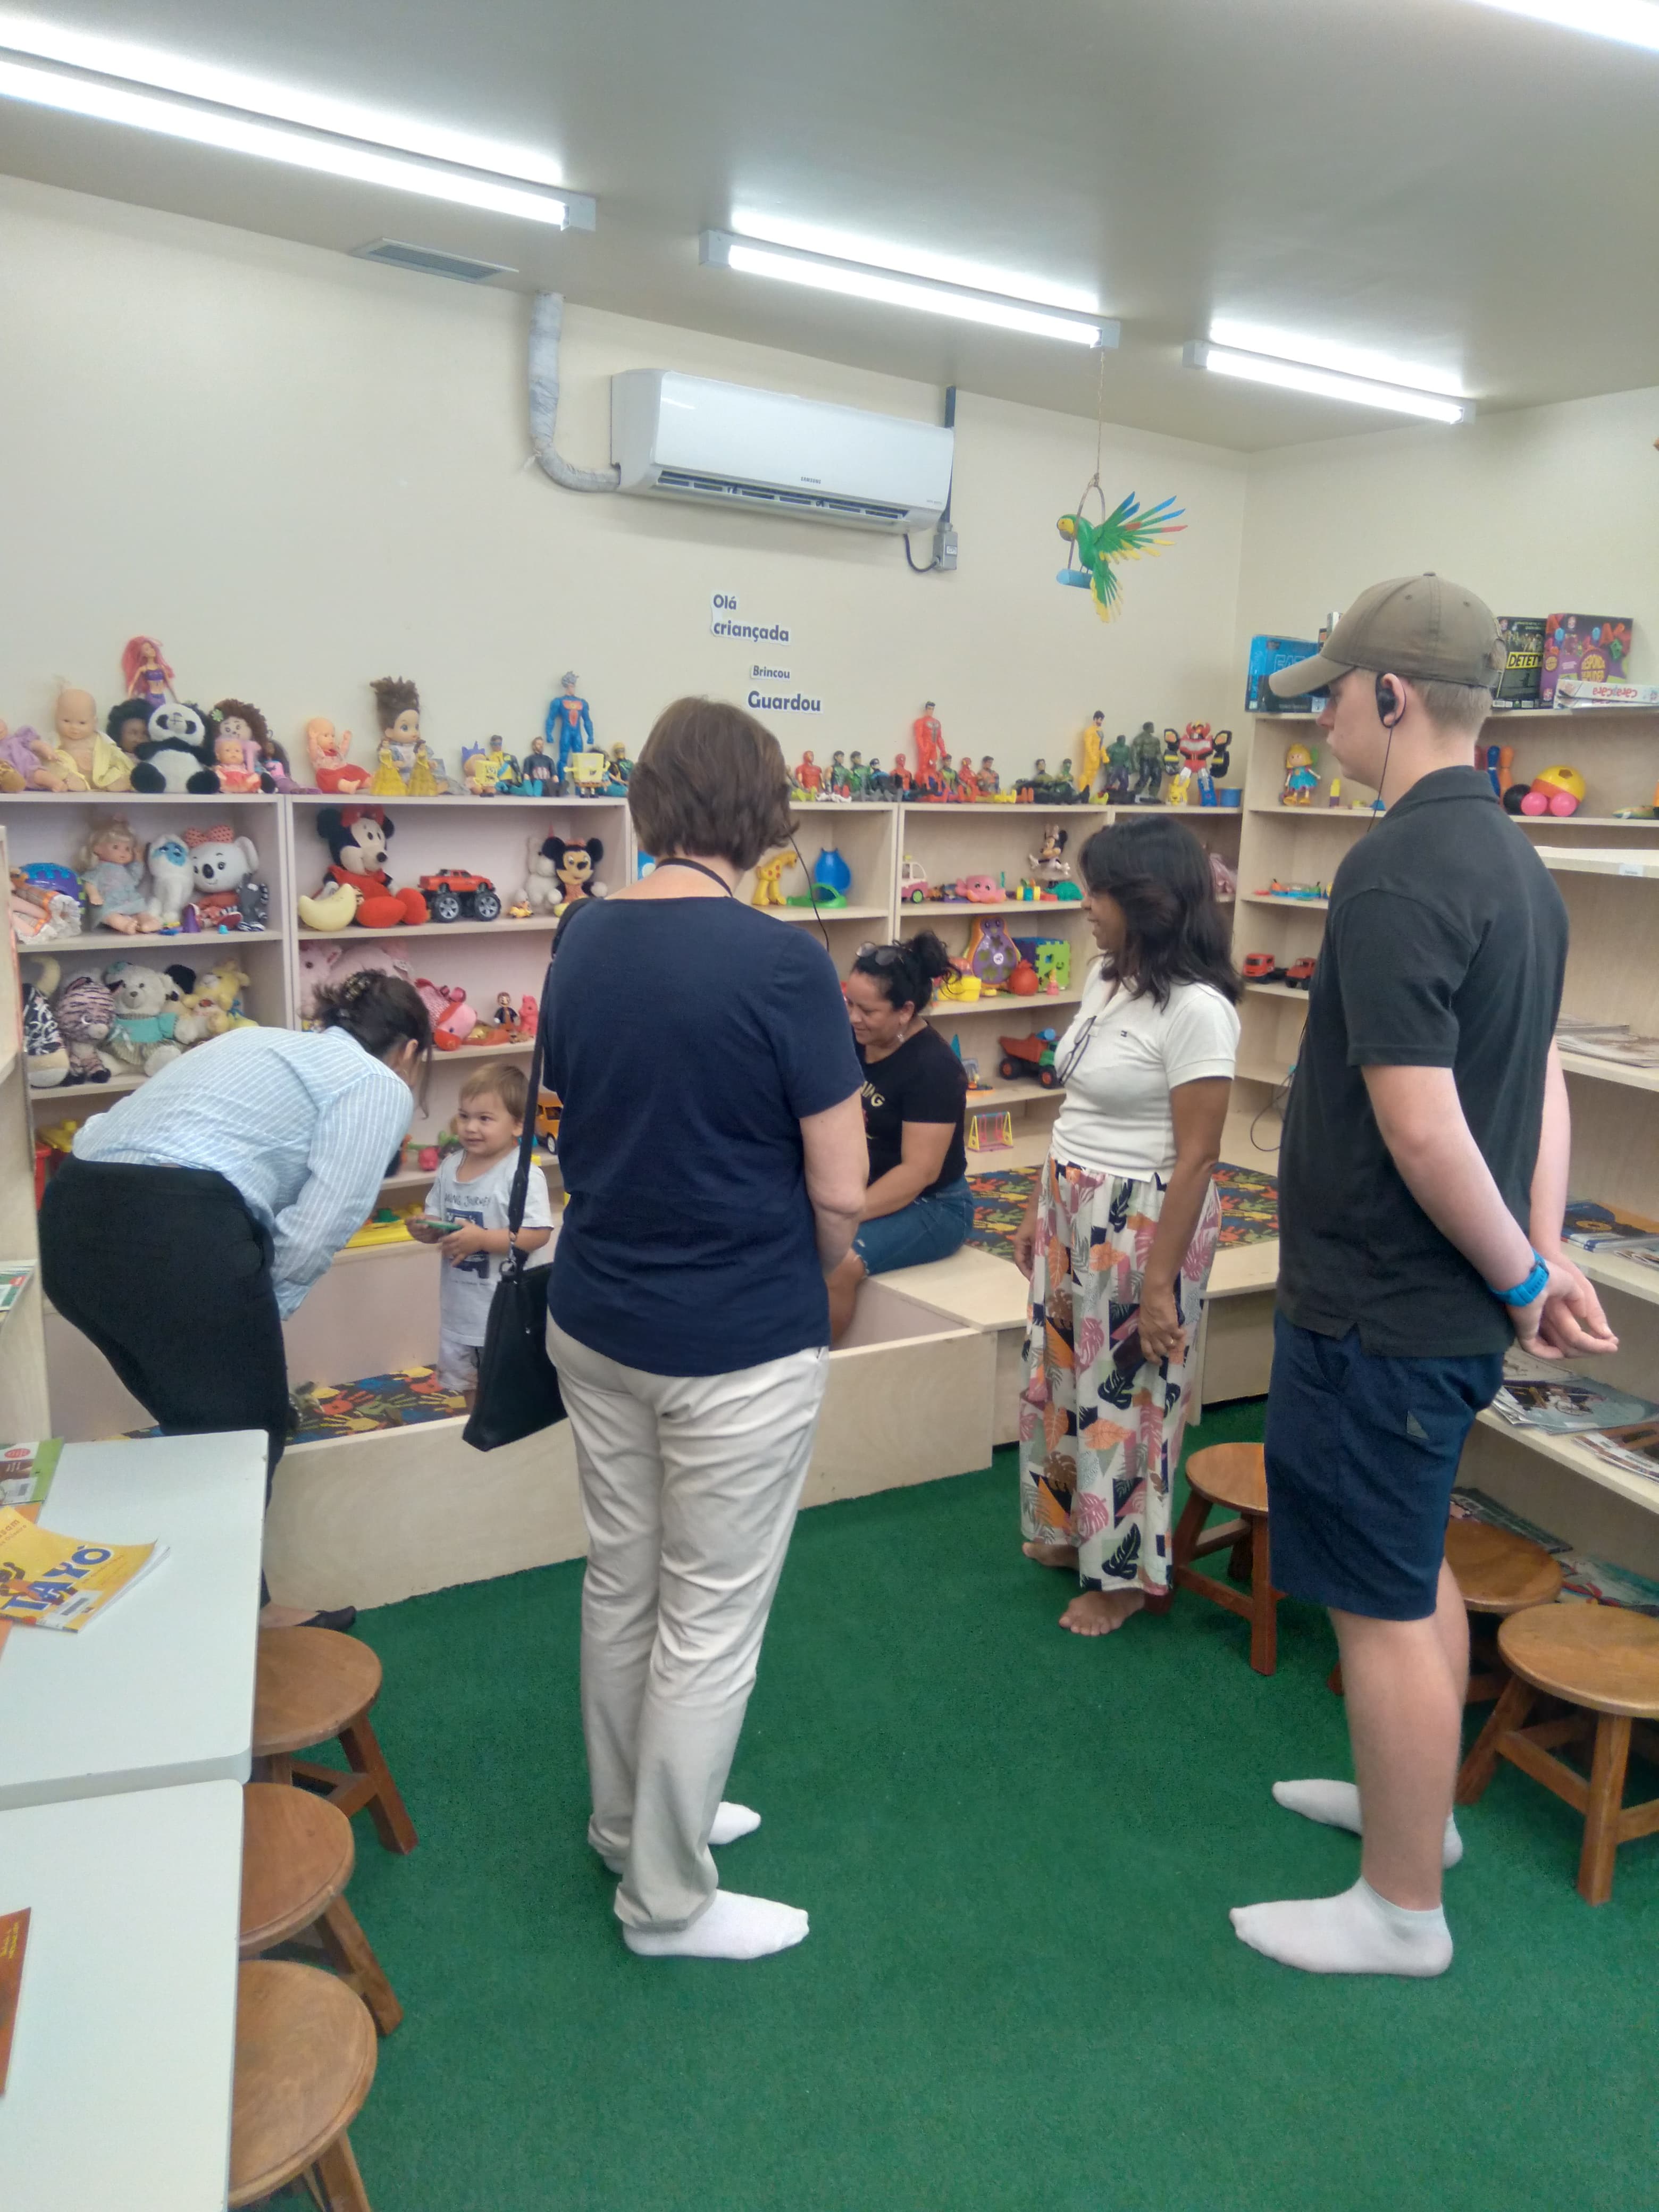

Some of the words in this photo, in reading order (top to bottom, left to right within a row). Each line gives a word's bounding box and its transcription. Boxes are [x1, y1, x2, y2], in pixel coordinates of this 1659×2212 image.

[713, 594, 736, 610] Olá
[714, 620, 789, 642] criançada
[753, 665, 790, 678] Brincou
[748, 691, 820, 711] Guardou
[0, 1519, 20, 1538] sam
